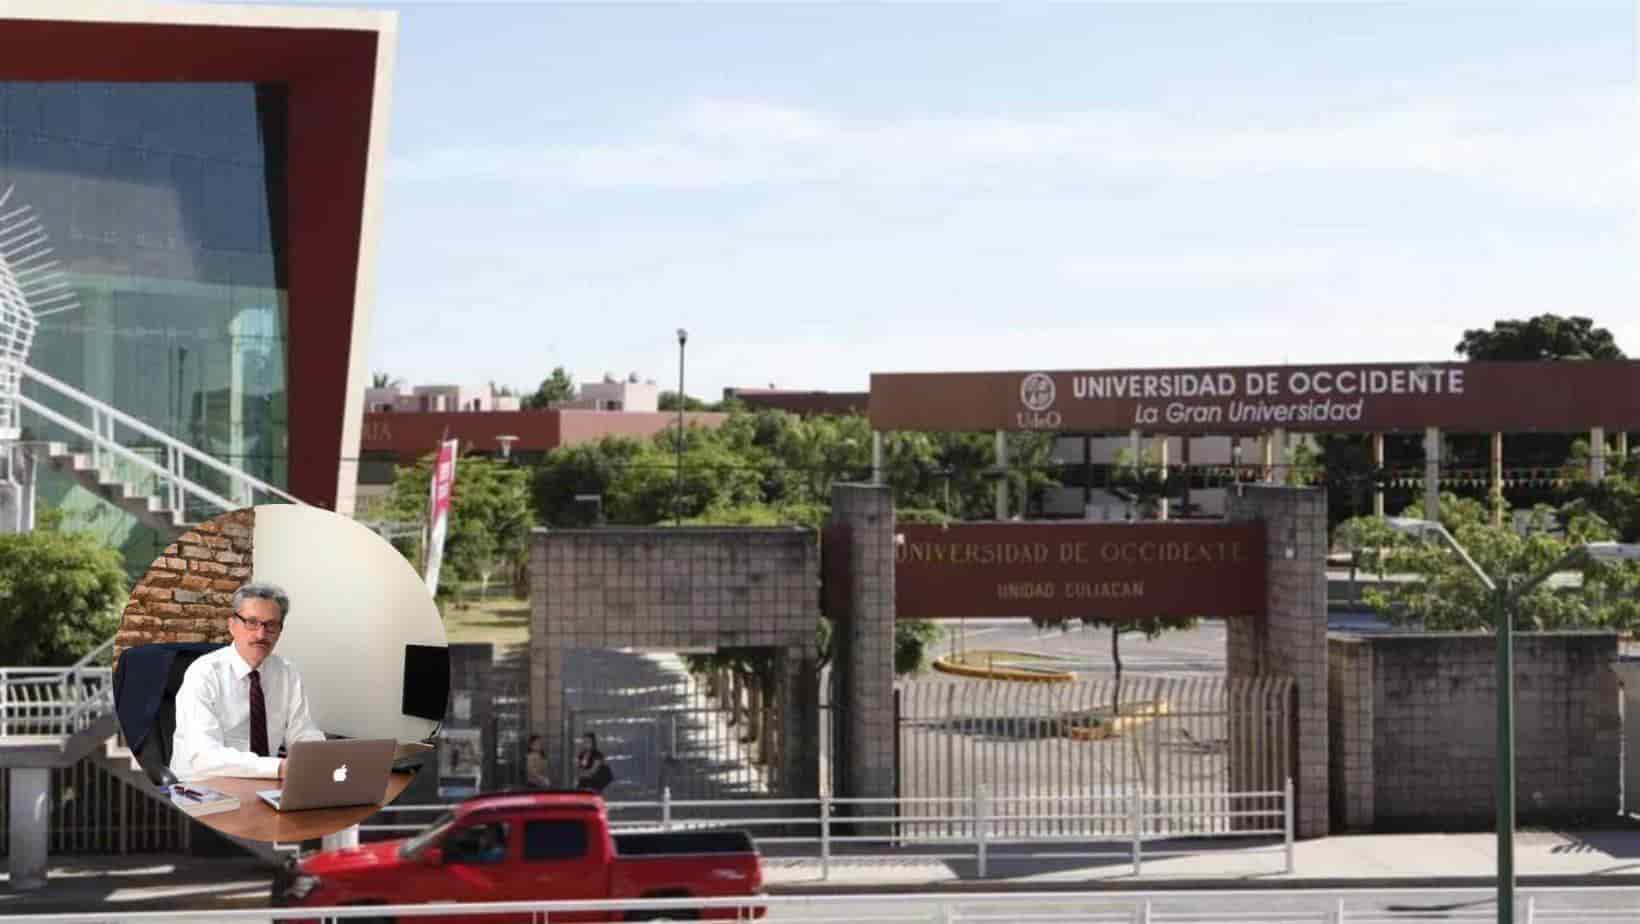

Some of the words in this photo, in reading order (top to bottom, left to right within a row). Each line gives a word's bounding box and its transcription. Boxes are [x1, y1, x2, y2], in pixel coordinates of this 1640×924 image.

[1072, 374, 1235, 398] UNIVERSIDAD
[1244, 372, 1279, 397] DE
[1288, 368, 1465, 395] OCCIDENTE
[1134, 403, 1158, 425] La
[1165, 402, 1221, 424] Gran
[1228, 399, 1363, 423] Universidad
[1059, 541, 1089, 563] DE
[1100, 541, 1245, 562] OCCIDENTE
[997, 582, 1055, 599] UNIDAD
